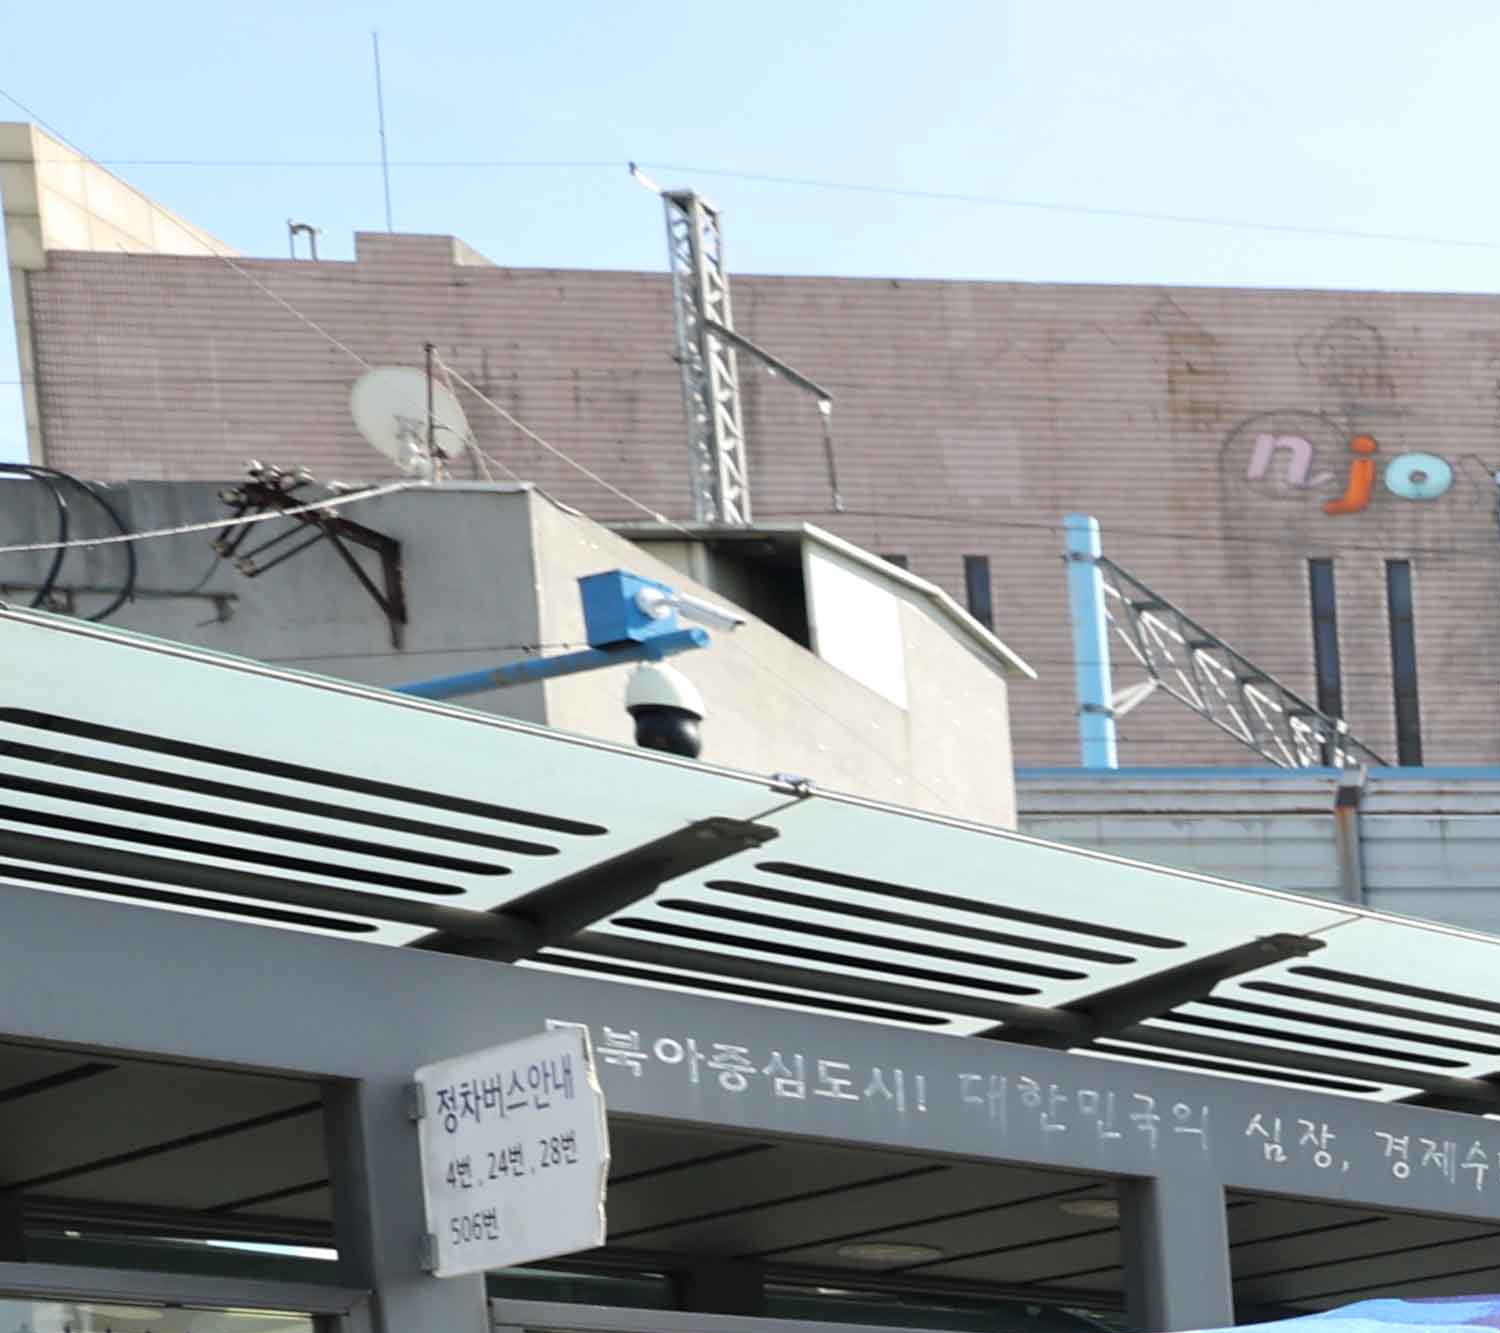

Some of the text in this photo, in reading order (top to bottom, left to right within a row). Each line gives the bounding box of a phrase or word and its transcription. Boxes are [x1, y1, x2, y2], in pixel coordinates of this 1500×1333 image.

[436, 1054, 575, 1134] 정차버스안내
[546, 1018, 926, 1112] 북아중심도시!
[958, 1074, 1208, 1150] 대한민국의
[1246, 1113, 1350, 1173] 심장,
[540, 1129, 577, 1168] 28번
[451, 1208, 499, 1245] 506번
